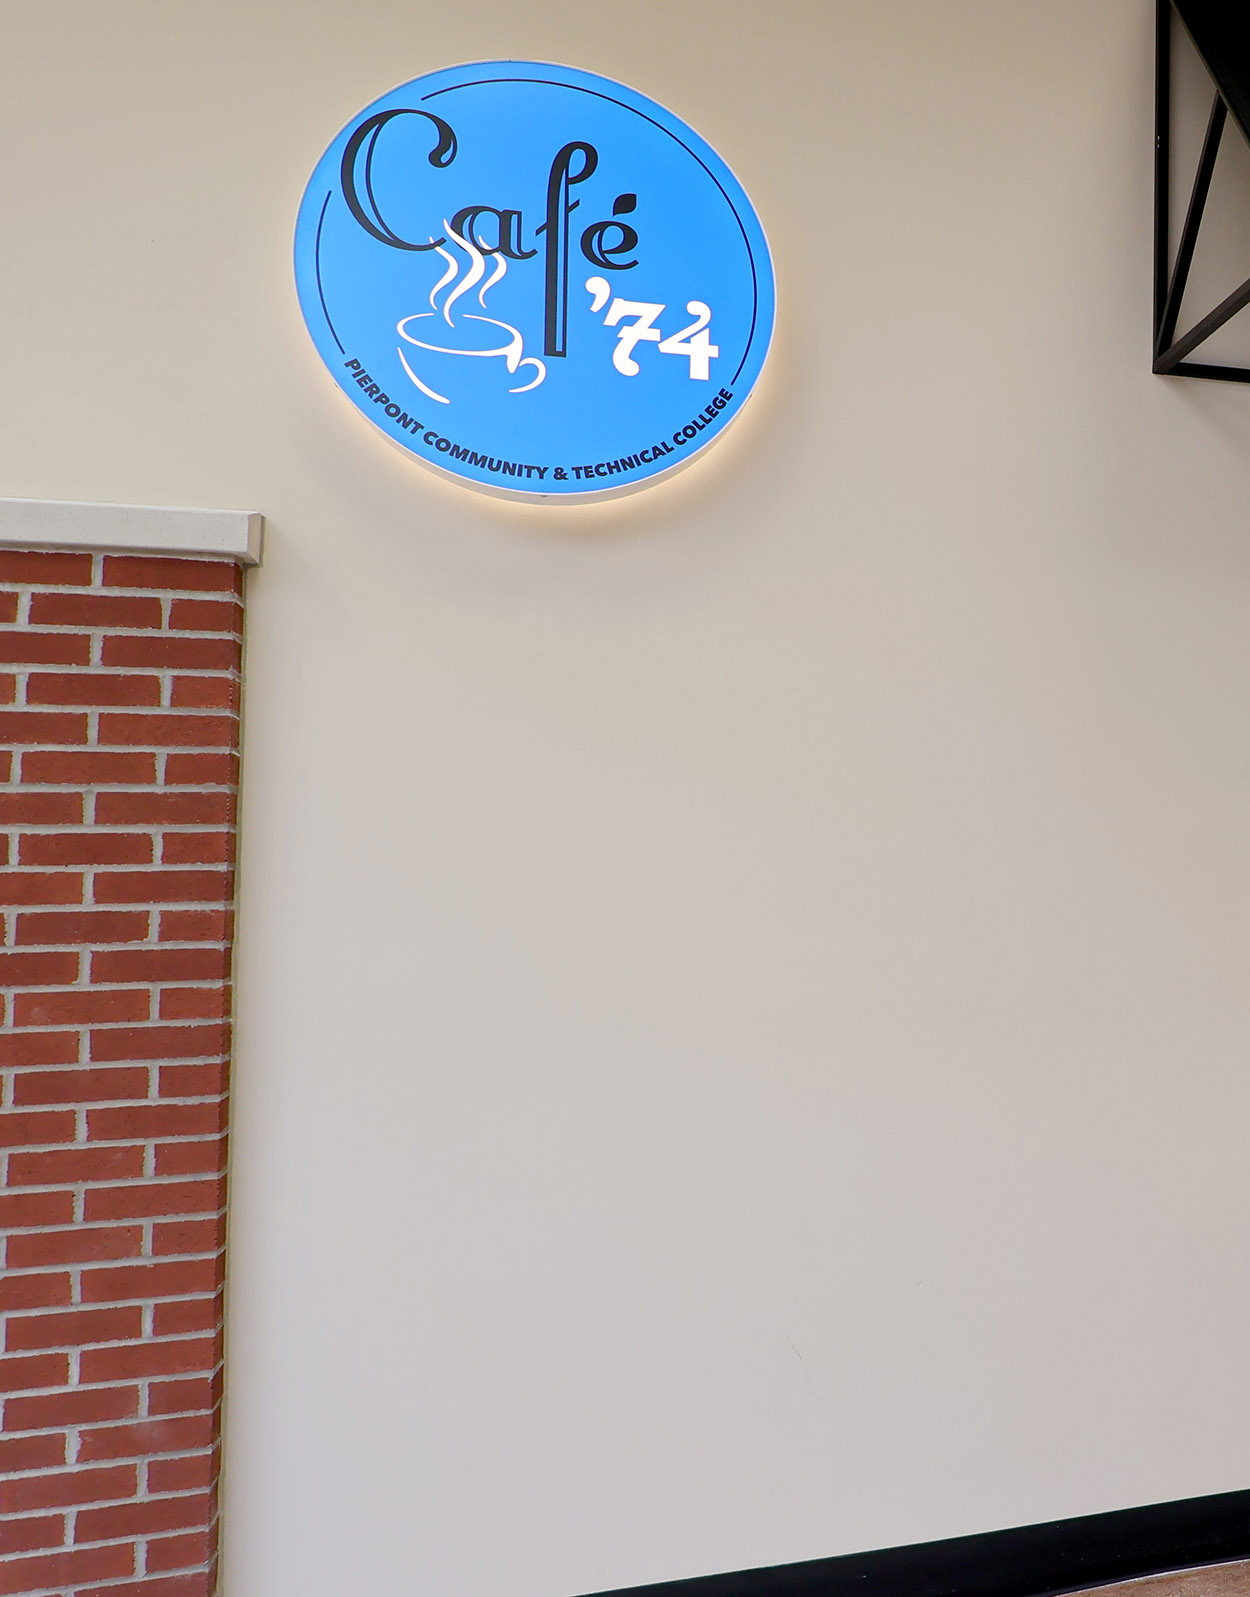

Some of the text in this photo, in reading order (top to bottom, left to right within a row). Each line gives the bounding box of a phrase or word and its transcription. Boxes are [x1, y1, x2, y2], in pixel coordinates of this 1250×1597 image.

[341, 108, 639, 357] Café
[584, 276, 719, 381] '74
[344, 358, 734, 480] PIERPONT COMMUNITY & TECHNICAL COLLEGE
